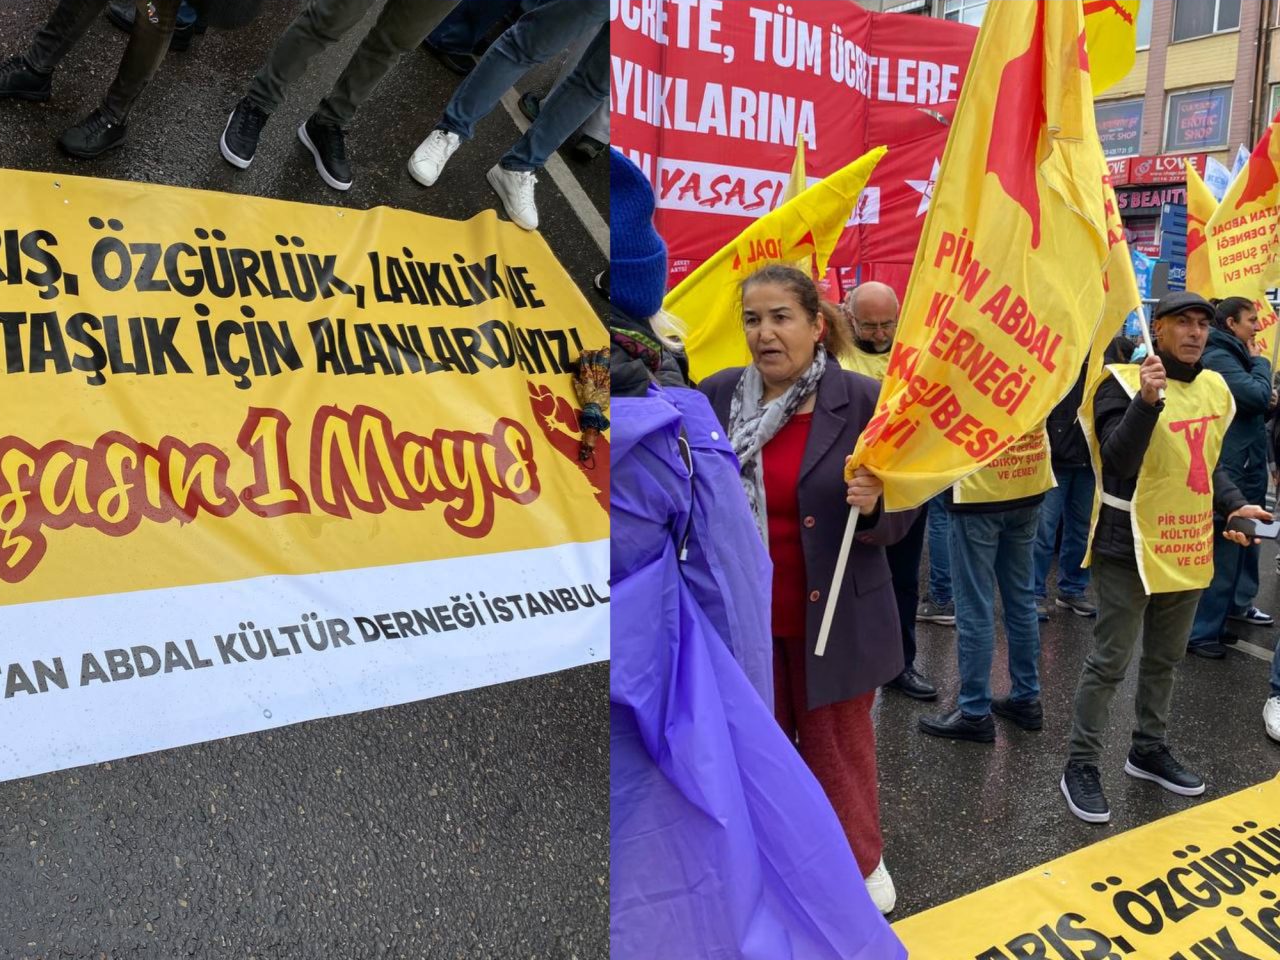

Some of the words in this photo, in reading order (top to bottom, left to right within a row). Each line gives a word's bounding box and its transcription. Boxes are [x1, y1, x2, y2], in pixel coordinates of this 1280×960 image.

[749, 3, 822, 76] TÜM
[88, 216, 365, 309] ÖZGÜRLÜK,
[193, 302, 304, 390] İÇİN
[979, 285, 1063, 374] ABDAL
[242, 406, 310, 516] 1
[312, 403, 540, 538] Mayıs
[1158, 513, 1176, 525] PİR
[1177, 555, 1190, 566] VE
[79, 639, 213, 688] ABDAL
[213, 612, 356, 664] KÜLTÜR
[355, 592, 486, 643] DERNEĞİ
